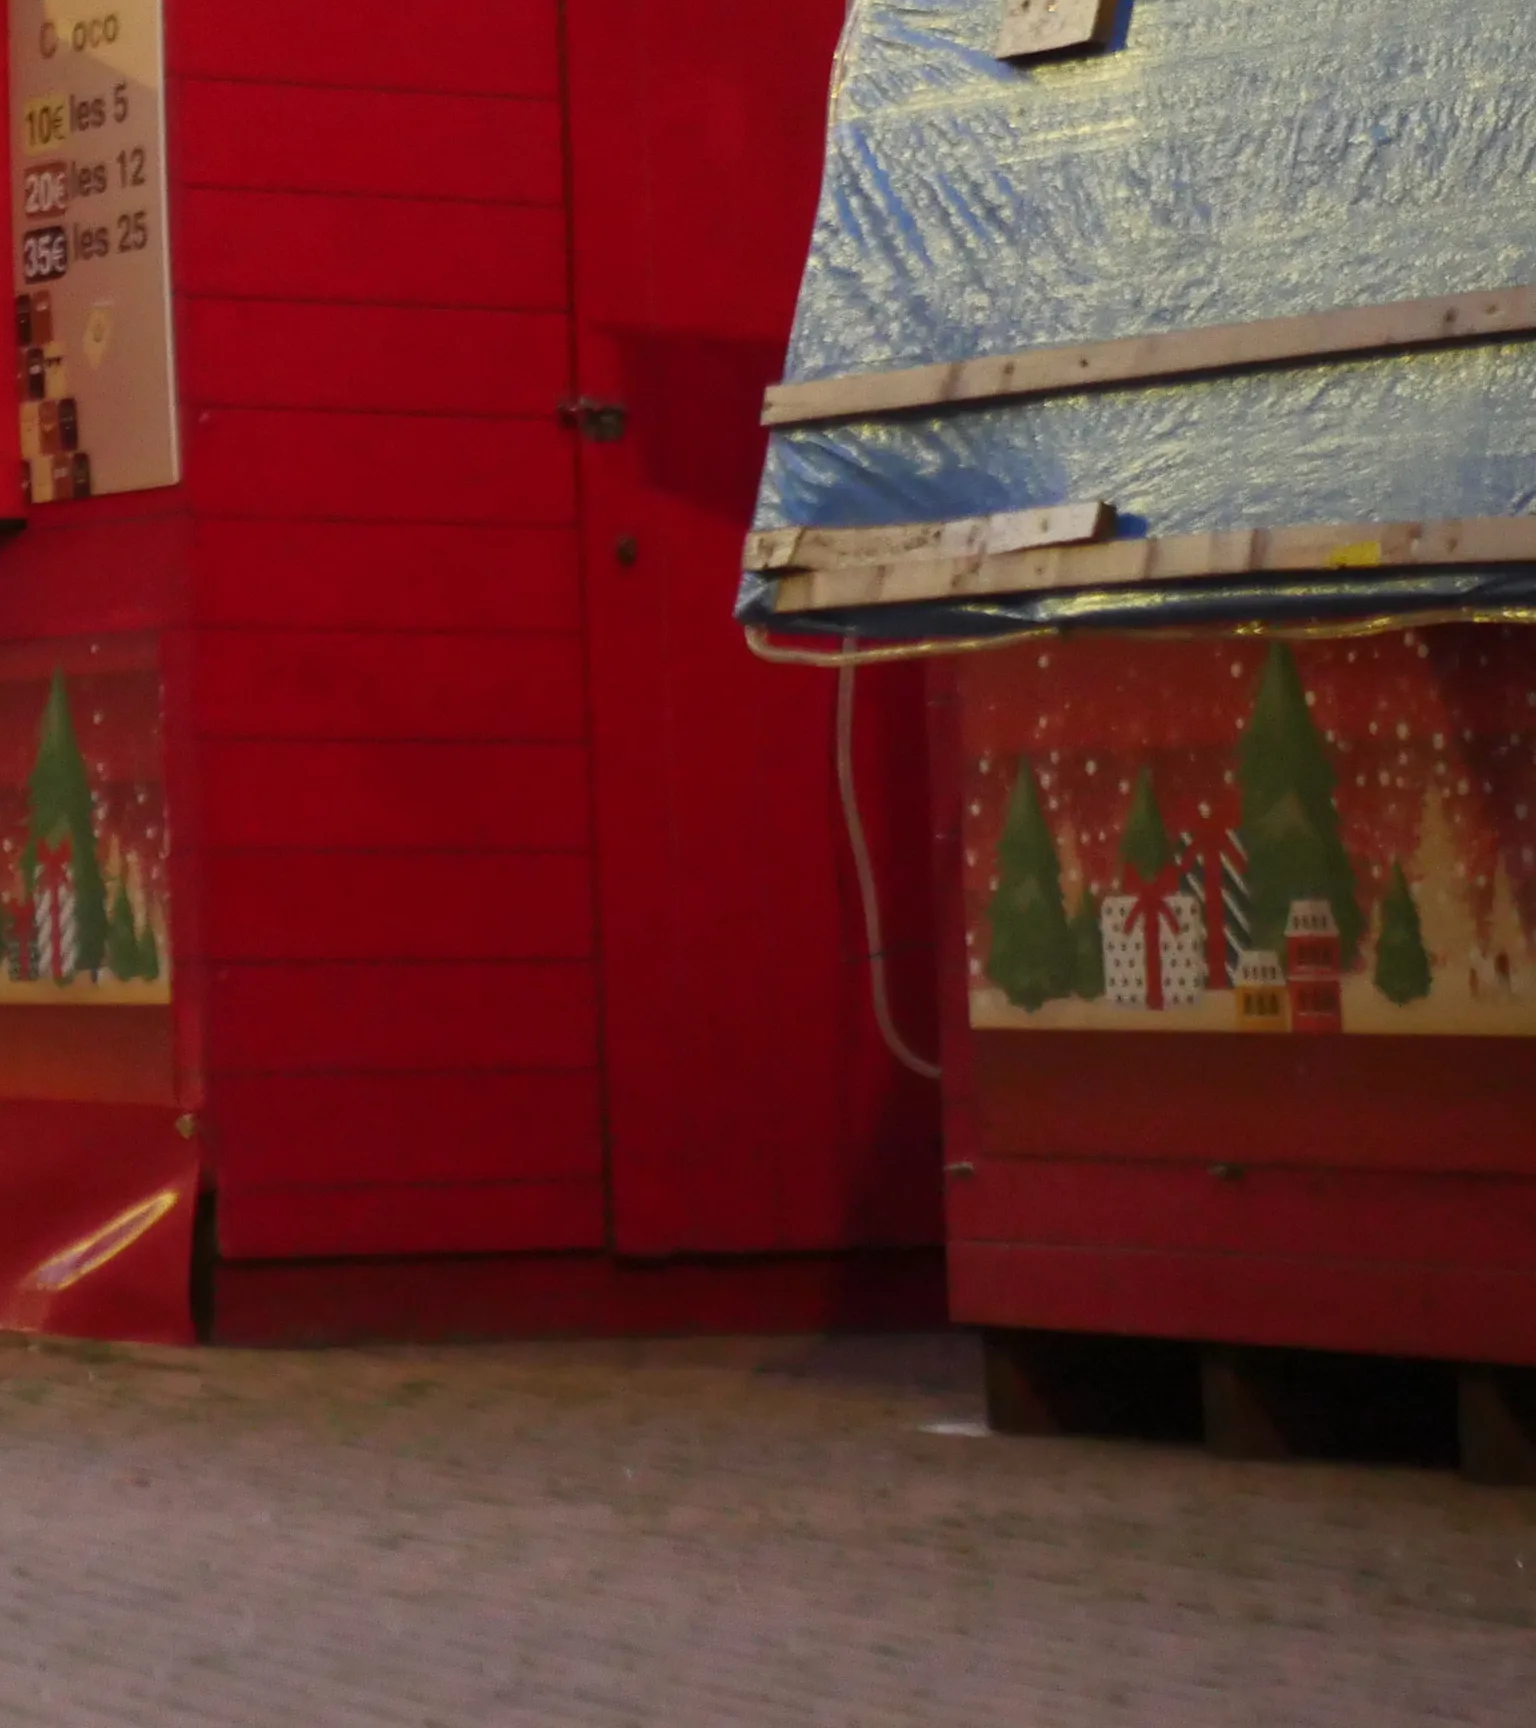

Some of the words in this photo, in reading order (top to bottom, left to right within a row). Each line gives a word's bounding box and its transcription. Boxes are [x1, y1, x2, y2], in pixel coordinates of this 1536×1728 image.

[27, 104, 66, 146] 10€
[69, 93, 106, 134] les
[114, 80, 128, 125] 5
[26, 170, 68, 215] 20€
[69, 160, 107, 201] les
[117, 147, 146, 188] 12
[25, 234, 67, 279] 35€
[73, 220, 109, 262] les
[118, 210, 148, 254] 25
